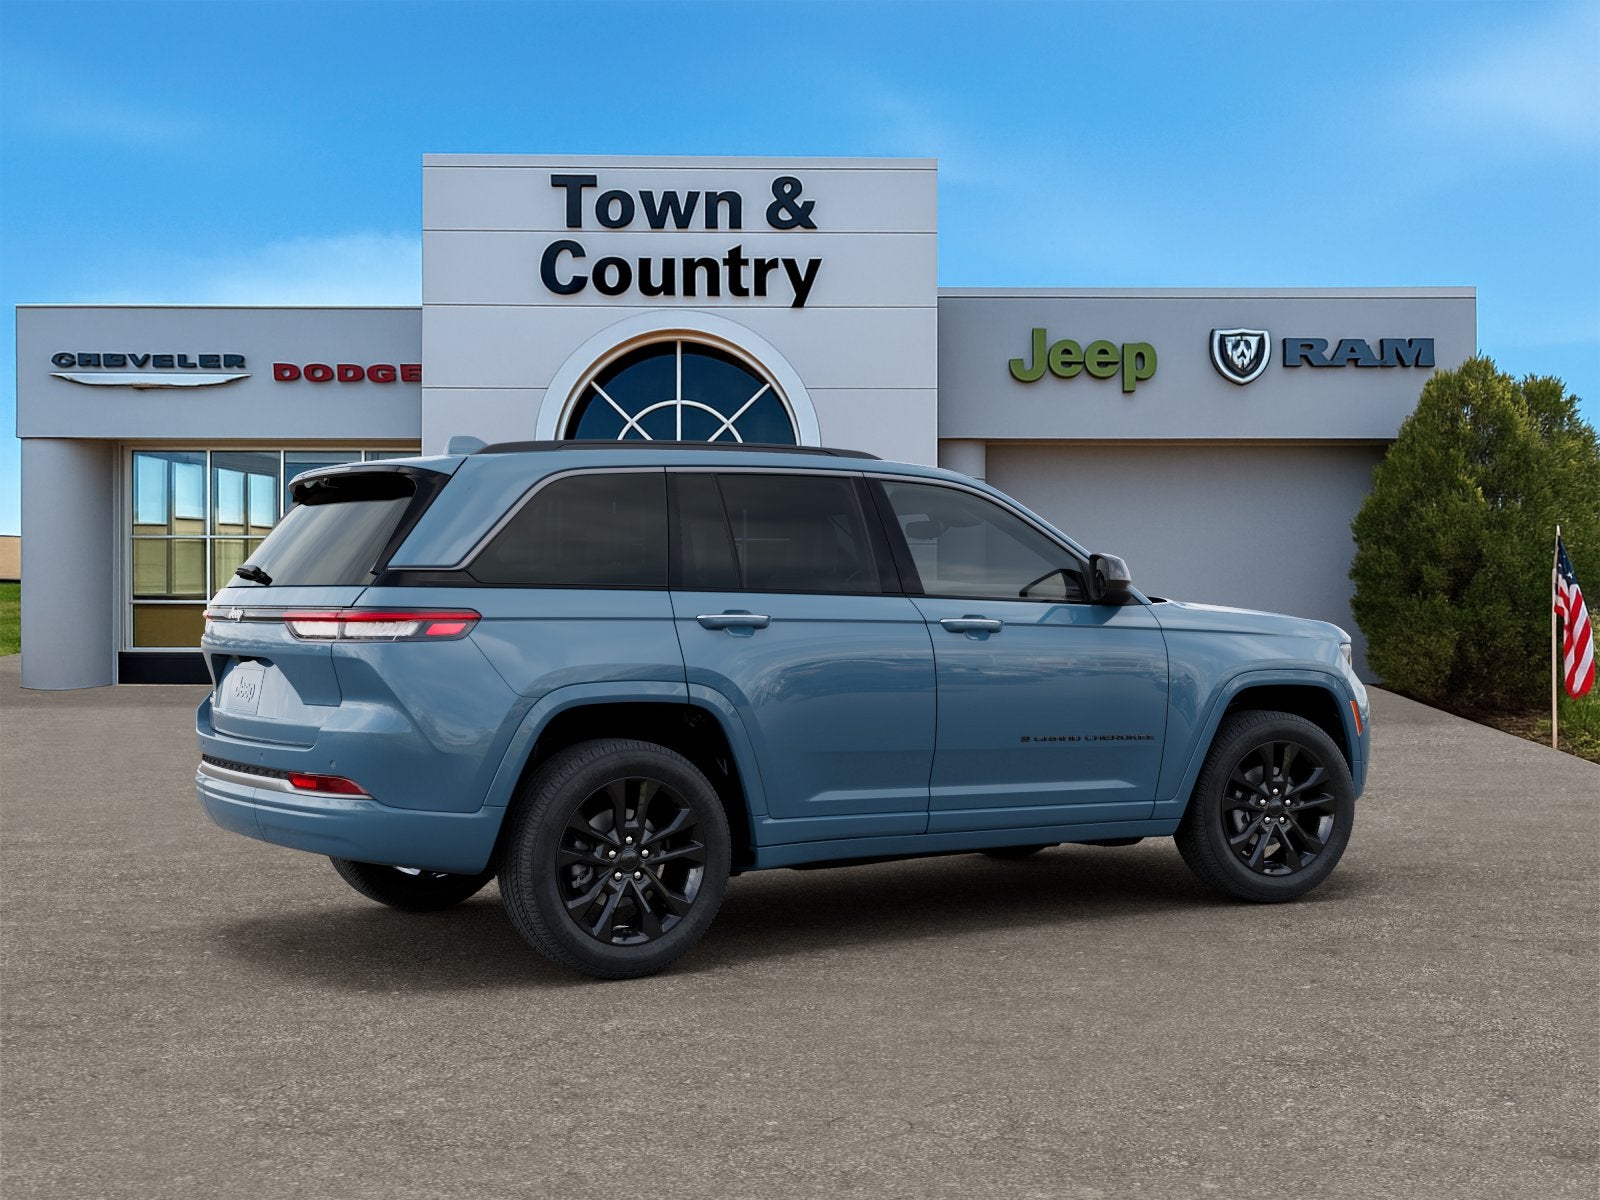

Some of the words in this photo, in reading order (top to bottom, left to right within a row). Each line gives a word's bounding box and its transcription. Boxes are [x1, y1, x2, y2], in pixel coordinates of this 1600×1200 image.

[550, 174, 743, 230] Town
[766, 175, 819, 230] &
[539, 239, 823, 308] Country
[273, 362, 422, 384] DODGE
[1008, 327, 1158, 393] Jeep
[1282, 337, 1436, 368] RAM
[1033, 735, 1082, 743] GRAND
[1084, 734, 1156, 742] CHEROKEE
